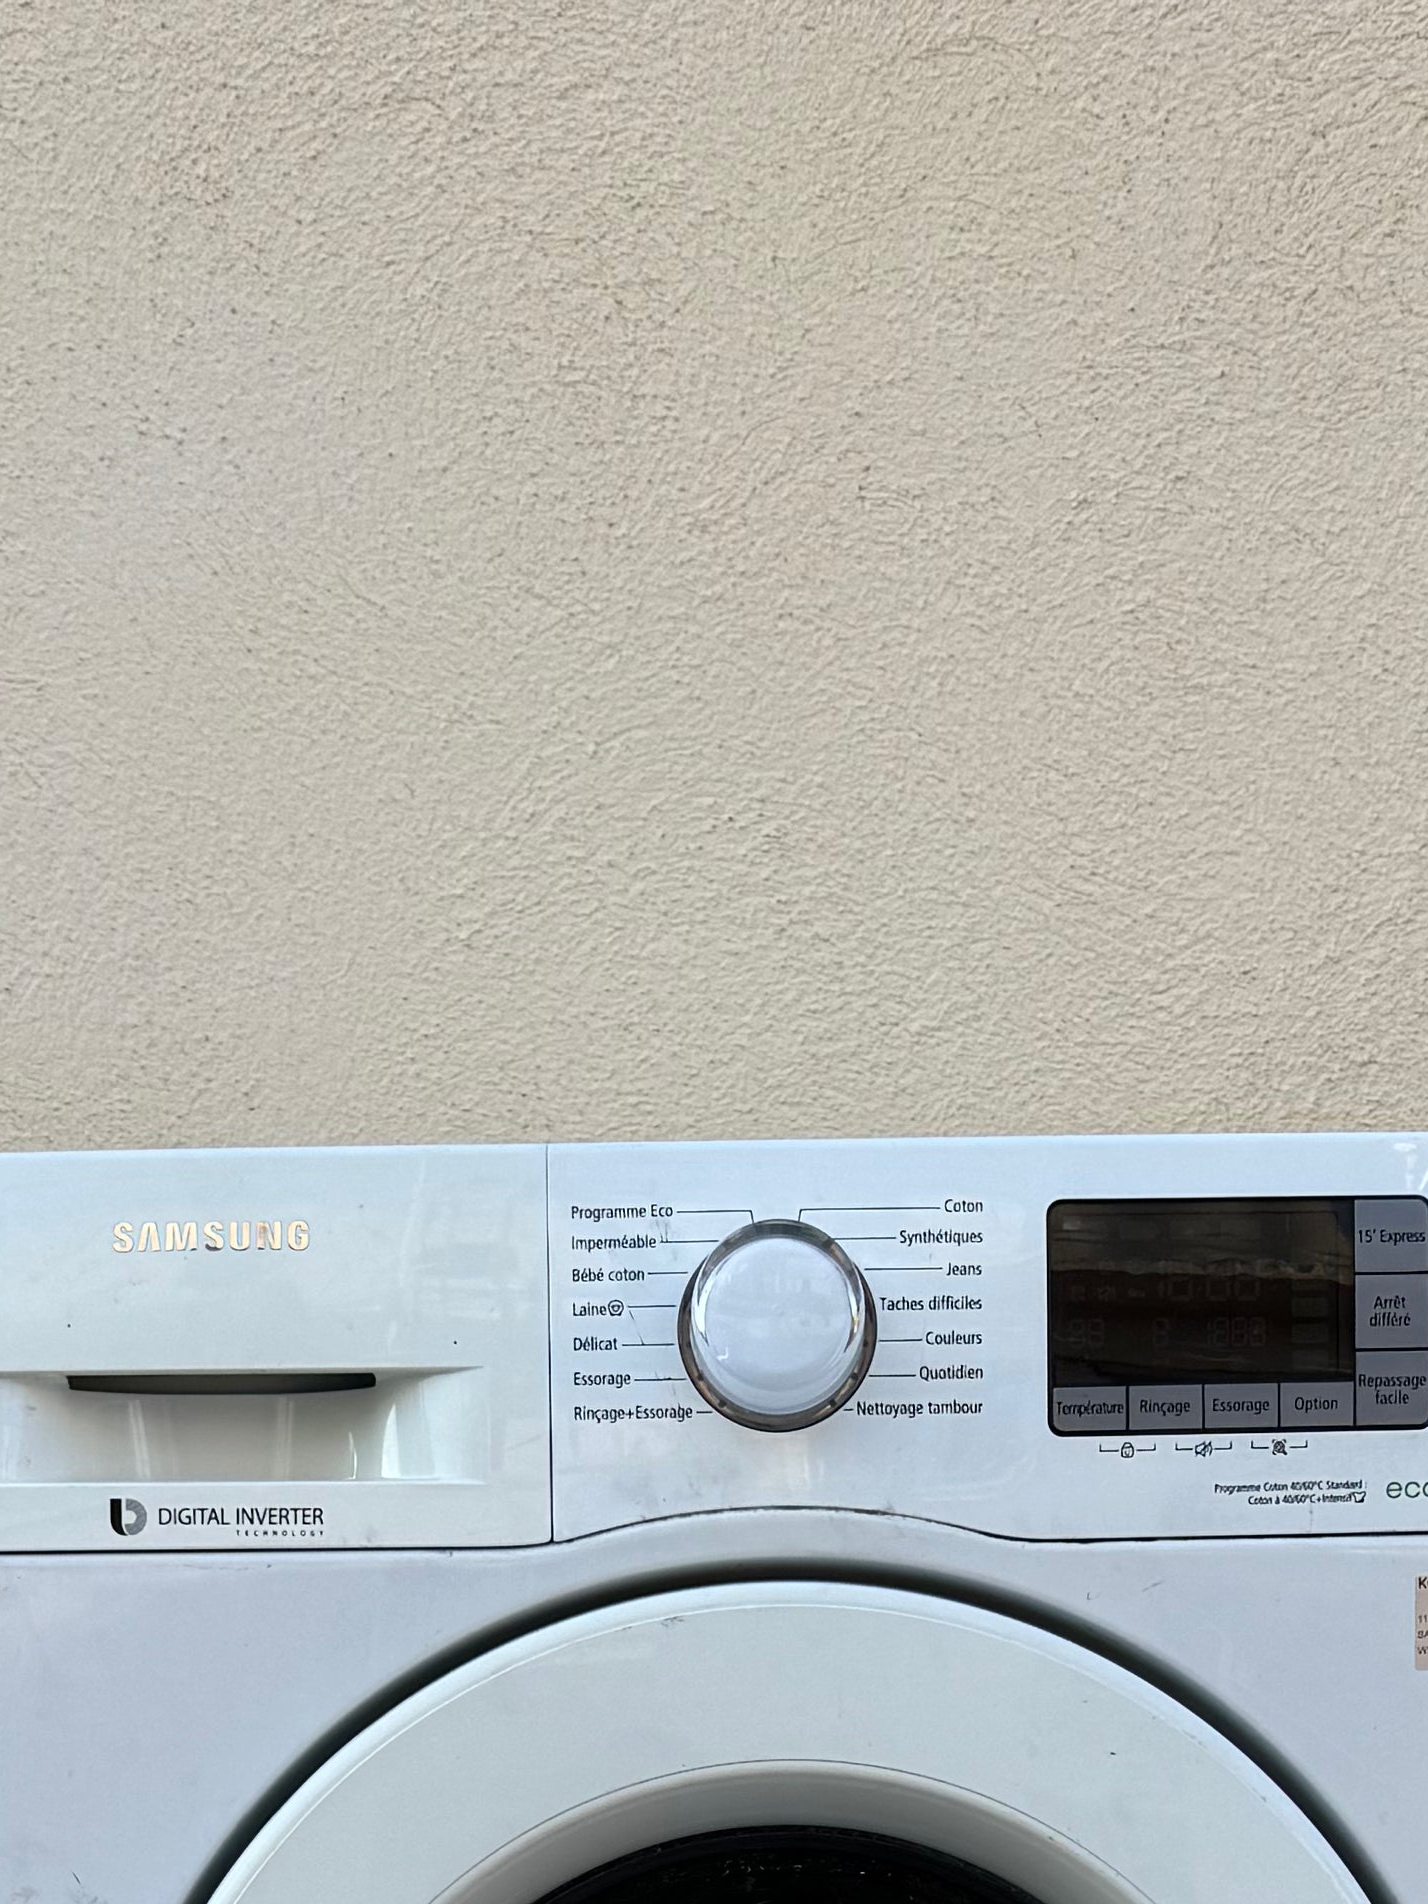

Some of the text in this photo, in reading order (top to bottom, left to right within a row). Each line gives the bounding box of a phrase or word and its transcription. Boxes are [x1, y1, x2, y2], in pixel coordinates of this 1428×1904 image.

[571, 1204, 674, 1222] Programme Eco
[944, 1198, 984, 1213] Coton
[112, 1220, 311, 1254] SAMSUNG
[571, 1234, 657, 1253] Imperméable
[899, 1229, 984, 1247] Synthétiques
[1380, 1229, 1426, 1246] Express
[572, 1268, 645, 1282] Bébé coton
[946, 1262, 983, 1276] Jeans
[572, 1303, 607, 1317] Laine
[879, 1295, 983, 1311] Taches difficiles
[1374, 1295, 1407, 1310] Arrêt
[1369, 1311, 1412, 1327] différé
[573, 1337, 618, 1351] Délicat
[925, 1330, 983, 1345] Couleurs
[573, 1371, 631, 1389] Essorage
[919, 1365, 984, 1382] Quotidien
[1358, 1373, 1427, 1391] Repassage
[1294, 1396, 1339, 1412] Option
[1375, 1389, 1410, 1405] facile
[856, 1399, 983, 1419] Nettoyage tambour
[1057, 1401, 1124, 1417] Température
[1139, 1399, 1192, 1416] Rinçage
[1212, 1398, 1270, 1414] Essorage
[574, 1405, 693, 1424] Rinçage+Essorage
[1214, 1483, 1261, 1495] Programme
[1263, 1482, 1288, 1492] Coton
[1248, 1495, 1273, 1505] Coton
[158, 1507, 324, 1525] DIGITAL INVERTER
[236, 1529, 324, 1537] TECHNOLOGY
